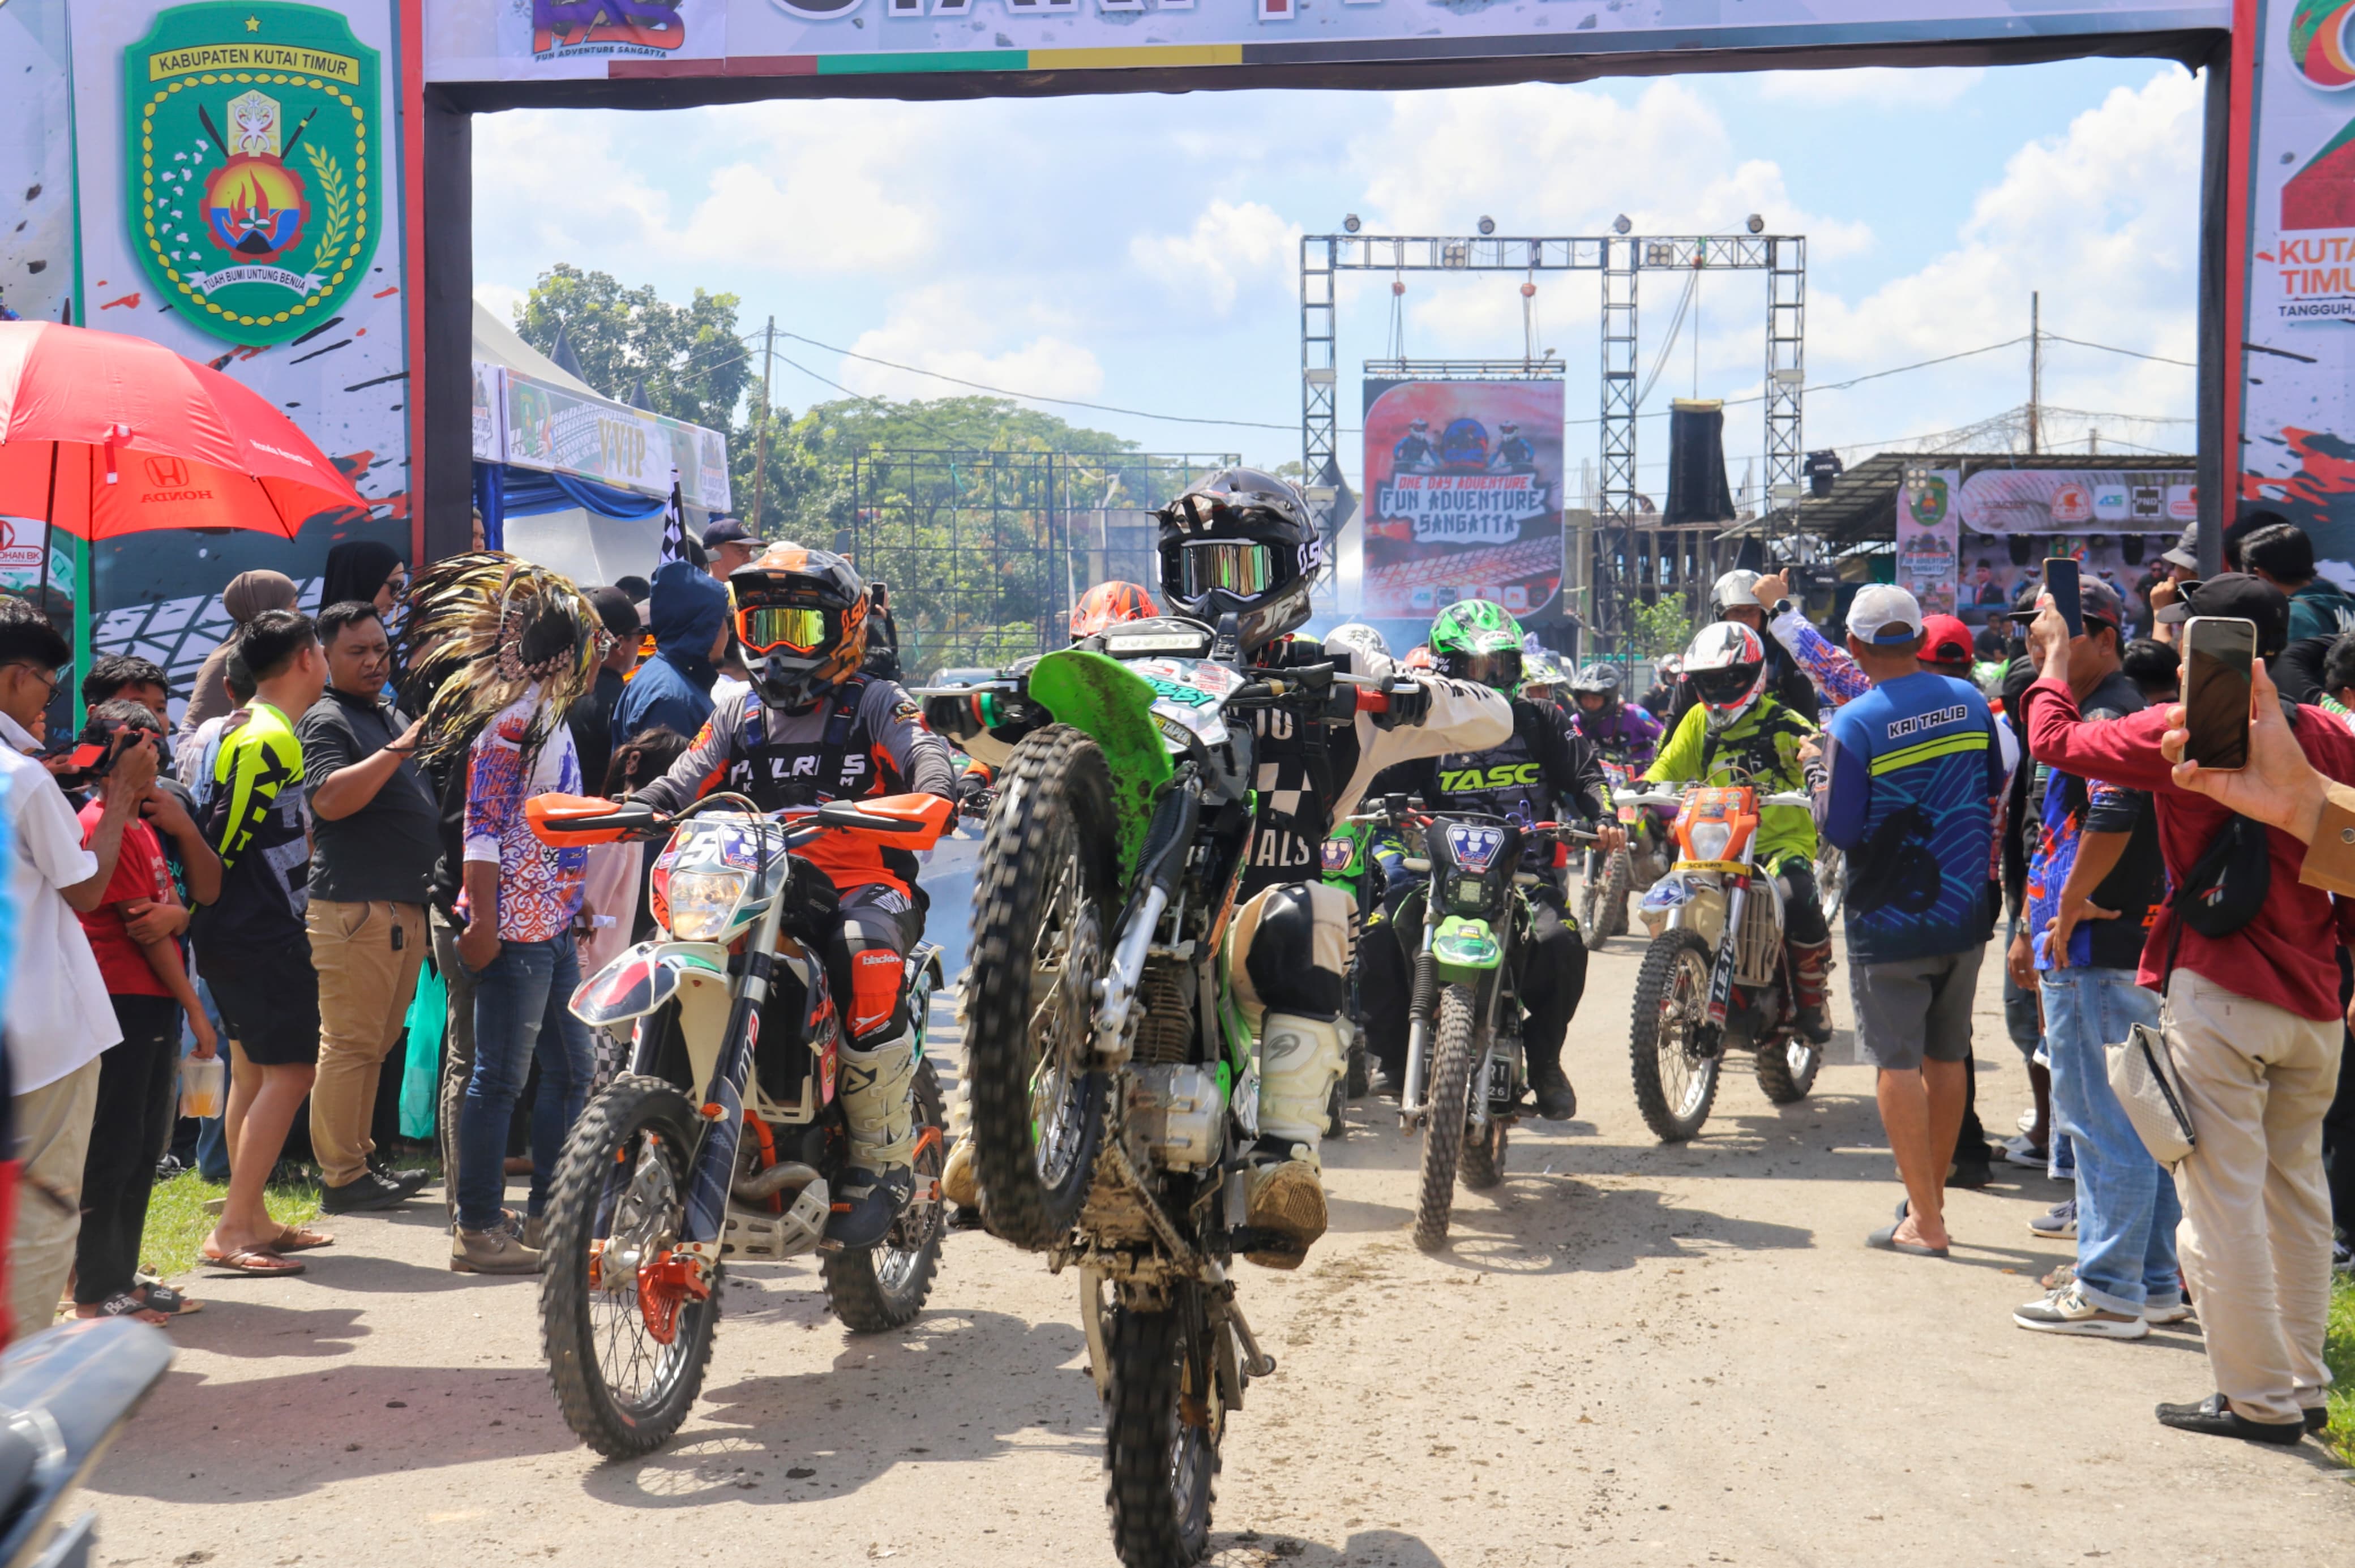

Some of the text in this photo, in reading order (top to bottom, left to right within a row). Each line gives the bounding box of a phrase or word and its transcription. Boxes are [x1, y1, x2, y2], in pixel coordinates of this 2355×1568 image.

[159, 49, 348, 76] KABUPATEN KUTAI TIMUR
[535, 46, 667, 62] FUN ADVENTURE SANGATTA
[204, 269, 306, 291] TUAH BUMI UNTUNG BENUA
[597, 417, 646, 478] VVIP
[1398, 475, 1529, 490] ONE DAY ADVENTURE
[1382, 491, 1540, 511] FUN ADVENTURE
[1419, 515, 1515, 534] SANGATTA
[27, 551, 40, 560] BK
[1888, 705, 1968, 739] KAI TALIB
[1438, 762, 1540, 791] TASC
